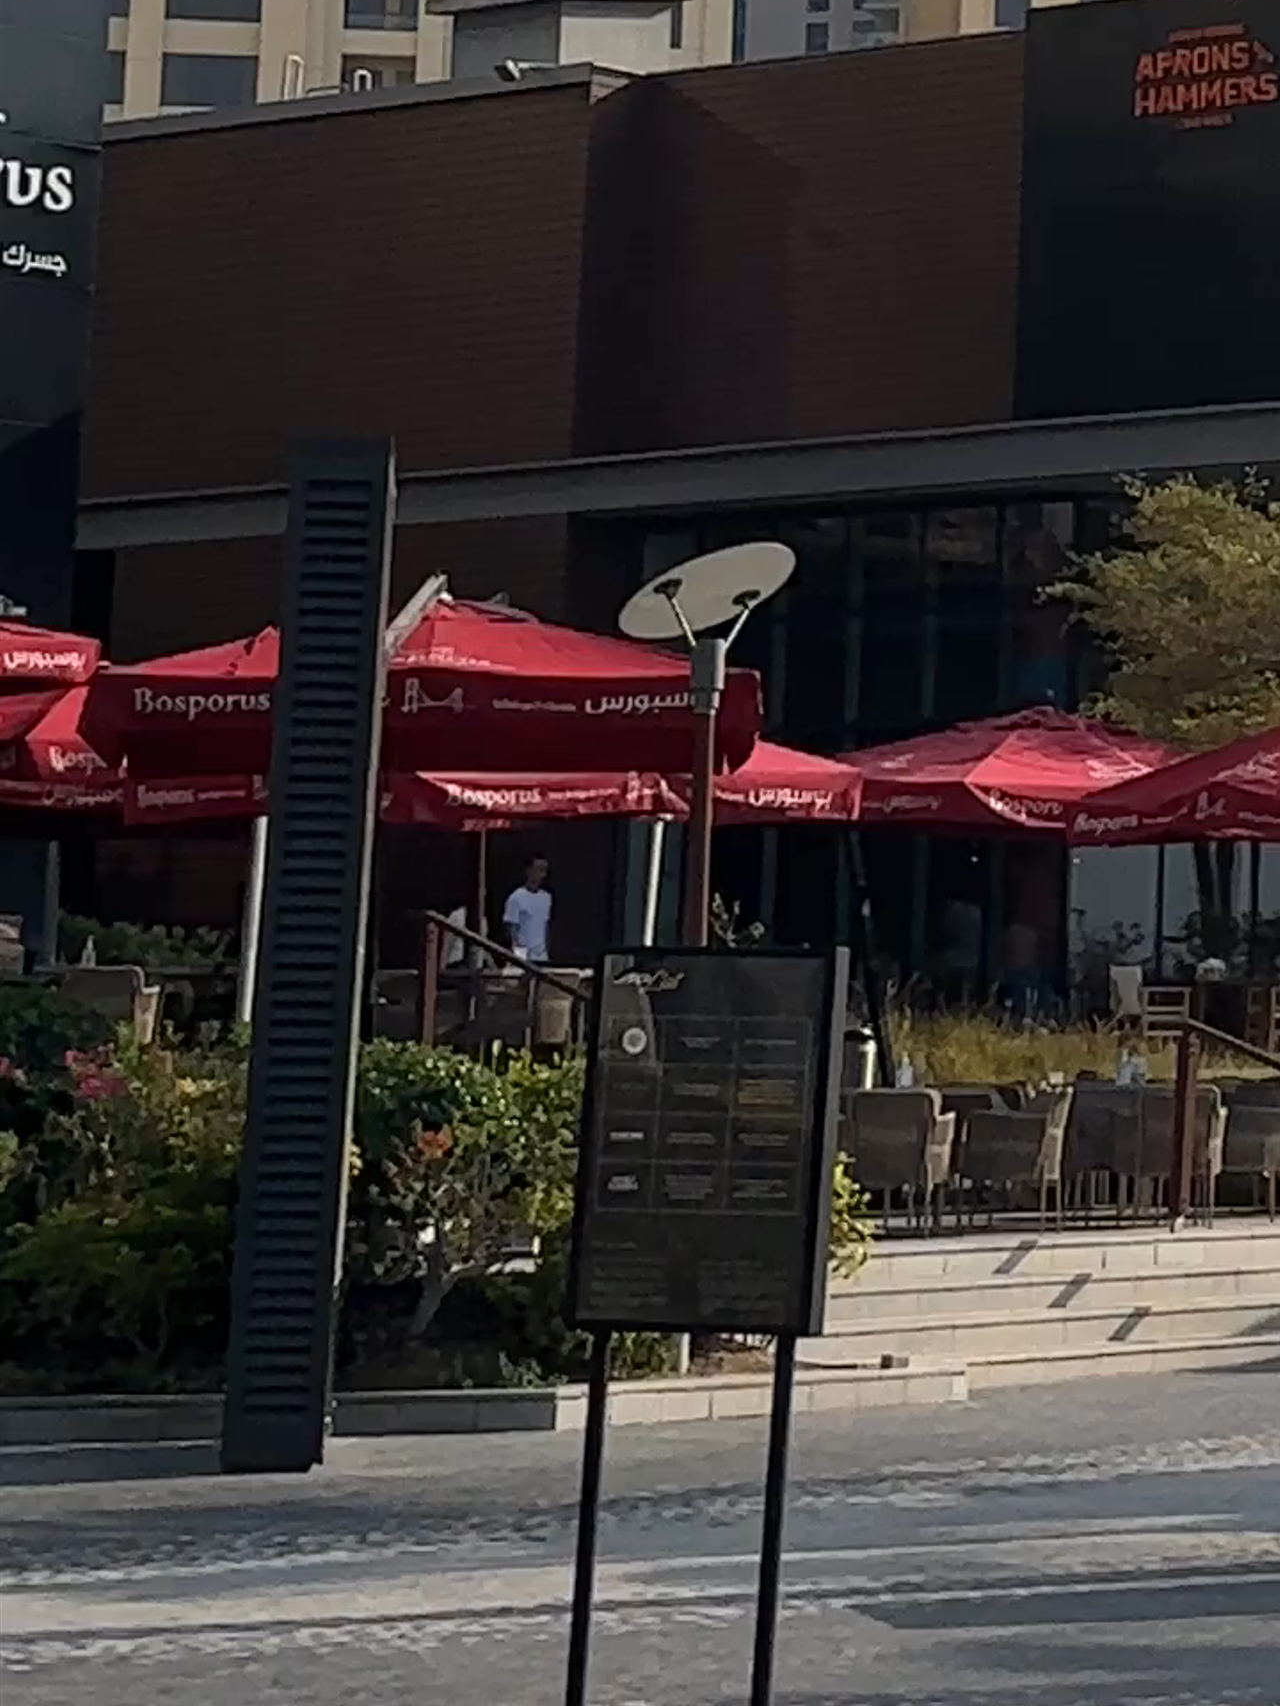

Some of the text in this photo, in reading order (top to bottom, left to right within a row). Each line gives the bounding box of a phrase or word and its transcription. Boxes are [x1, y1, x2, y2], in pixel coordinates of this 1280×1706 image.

[1135, 41, 1250, 82] APRONS
[1134, 72, 1279, 118] HAMMERS
[0, 158, 74, 212] us
[134, 686, 271, 721] Bosporus
[989, 788, 1063, 819] Bosporu
